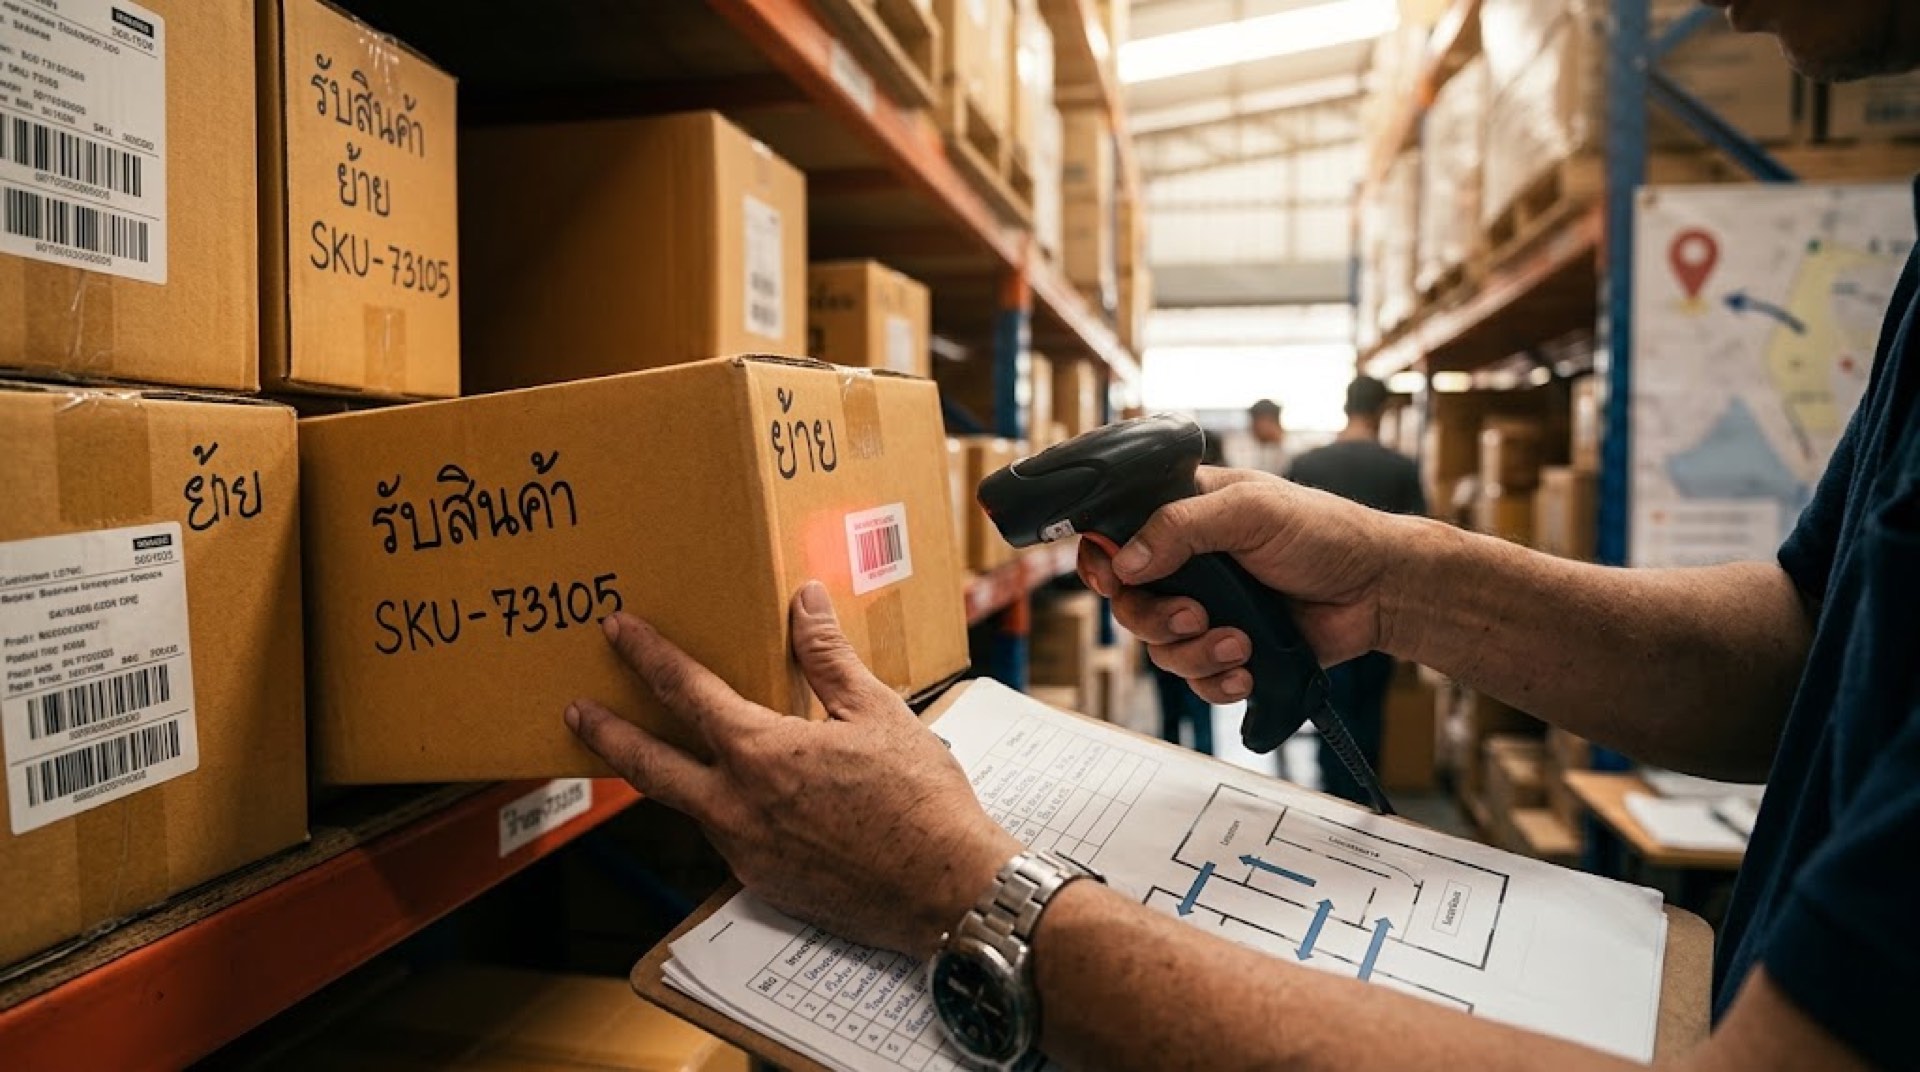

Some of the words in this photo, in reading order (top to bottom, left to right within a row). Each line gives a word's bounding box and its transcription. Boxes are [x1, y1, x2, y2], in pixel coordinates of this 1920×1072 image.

[310, 53, 425, 158] รับสินค้า
[337, 141, 392, 217] ย้าย
[310, 220, 451, 299] SKU-73105
[771, 387, 837, 479] ย้าย
[372, 451, 578, 554] รับสินค้า
[374, 573, 624, 655] SKU-73105
